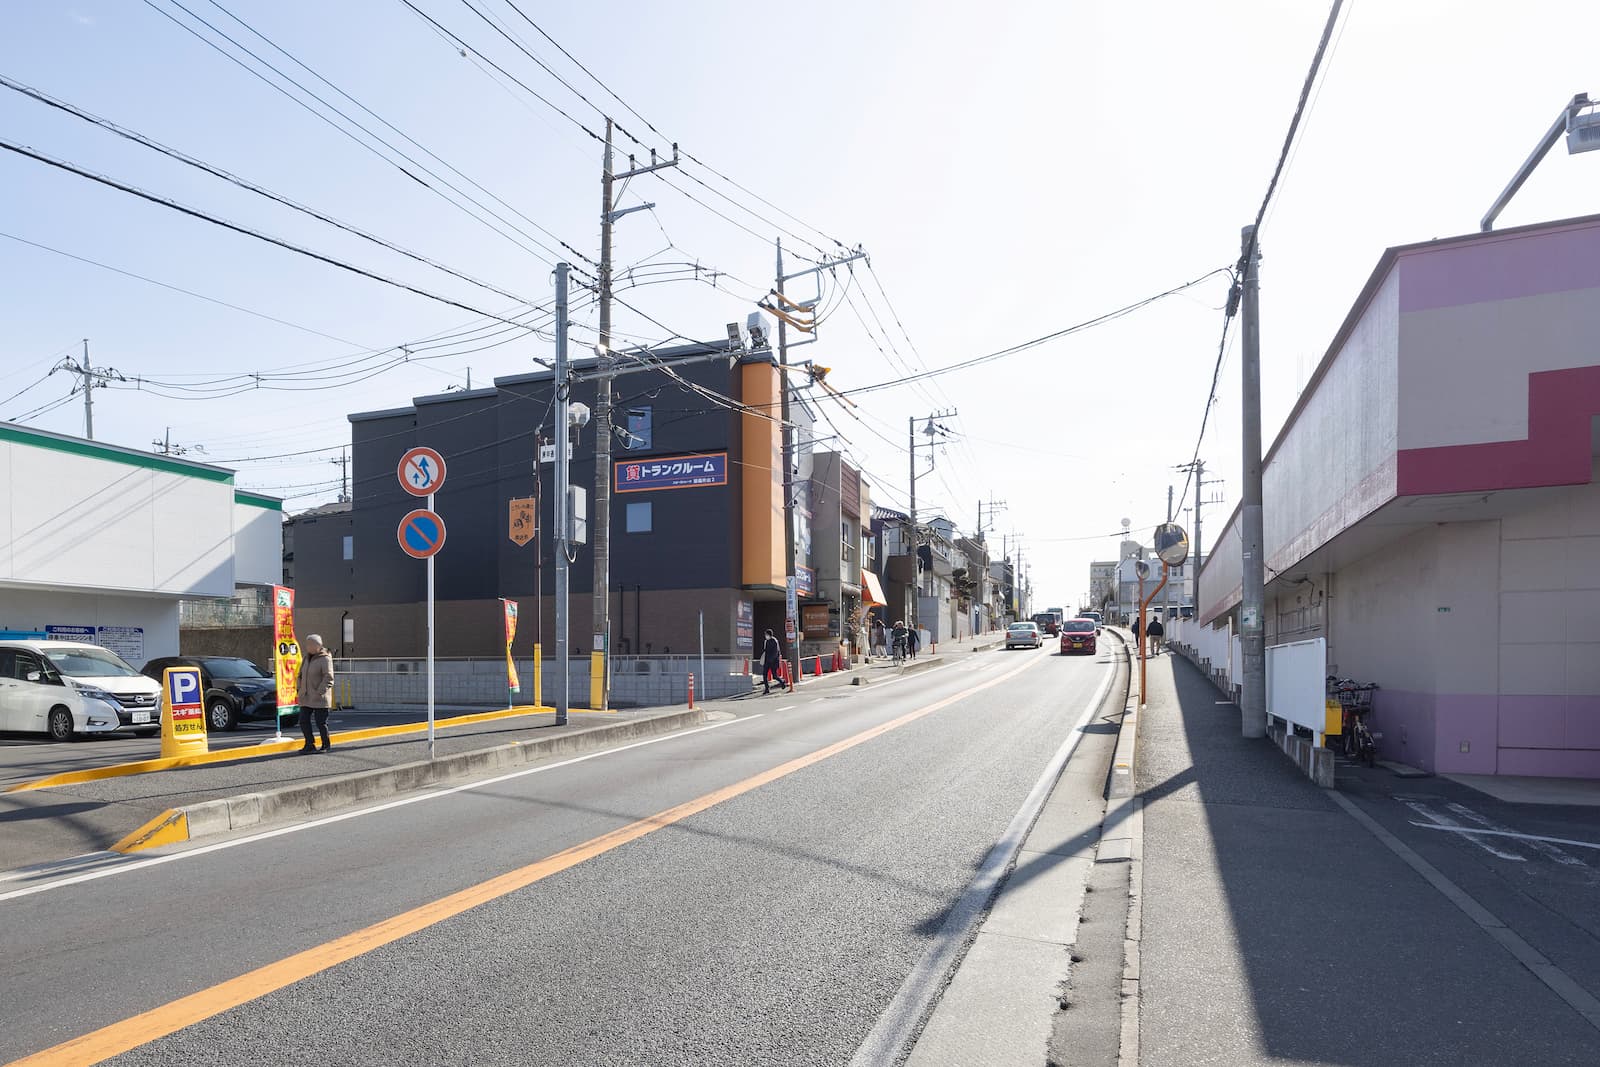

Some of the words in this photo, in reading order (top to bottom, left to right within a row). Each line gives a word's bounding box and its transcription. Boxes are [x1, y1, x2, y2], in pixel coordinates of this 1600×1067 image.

[626, 461, 715, 481] 貸トランクルーム
[173, 672, 197, 703] P
[280, 687, 296, 697] OFF
